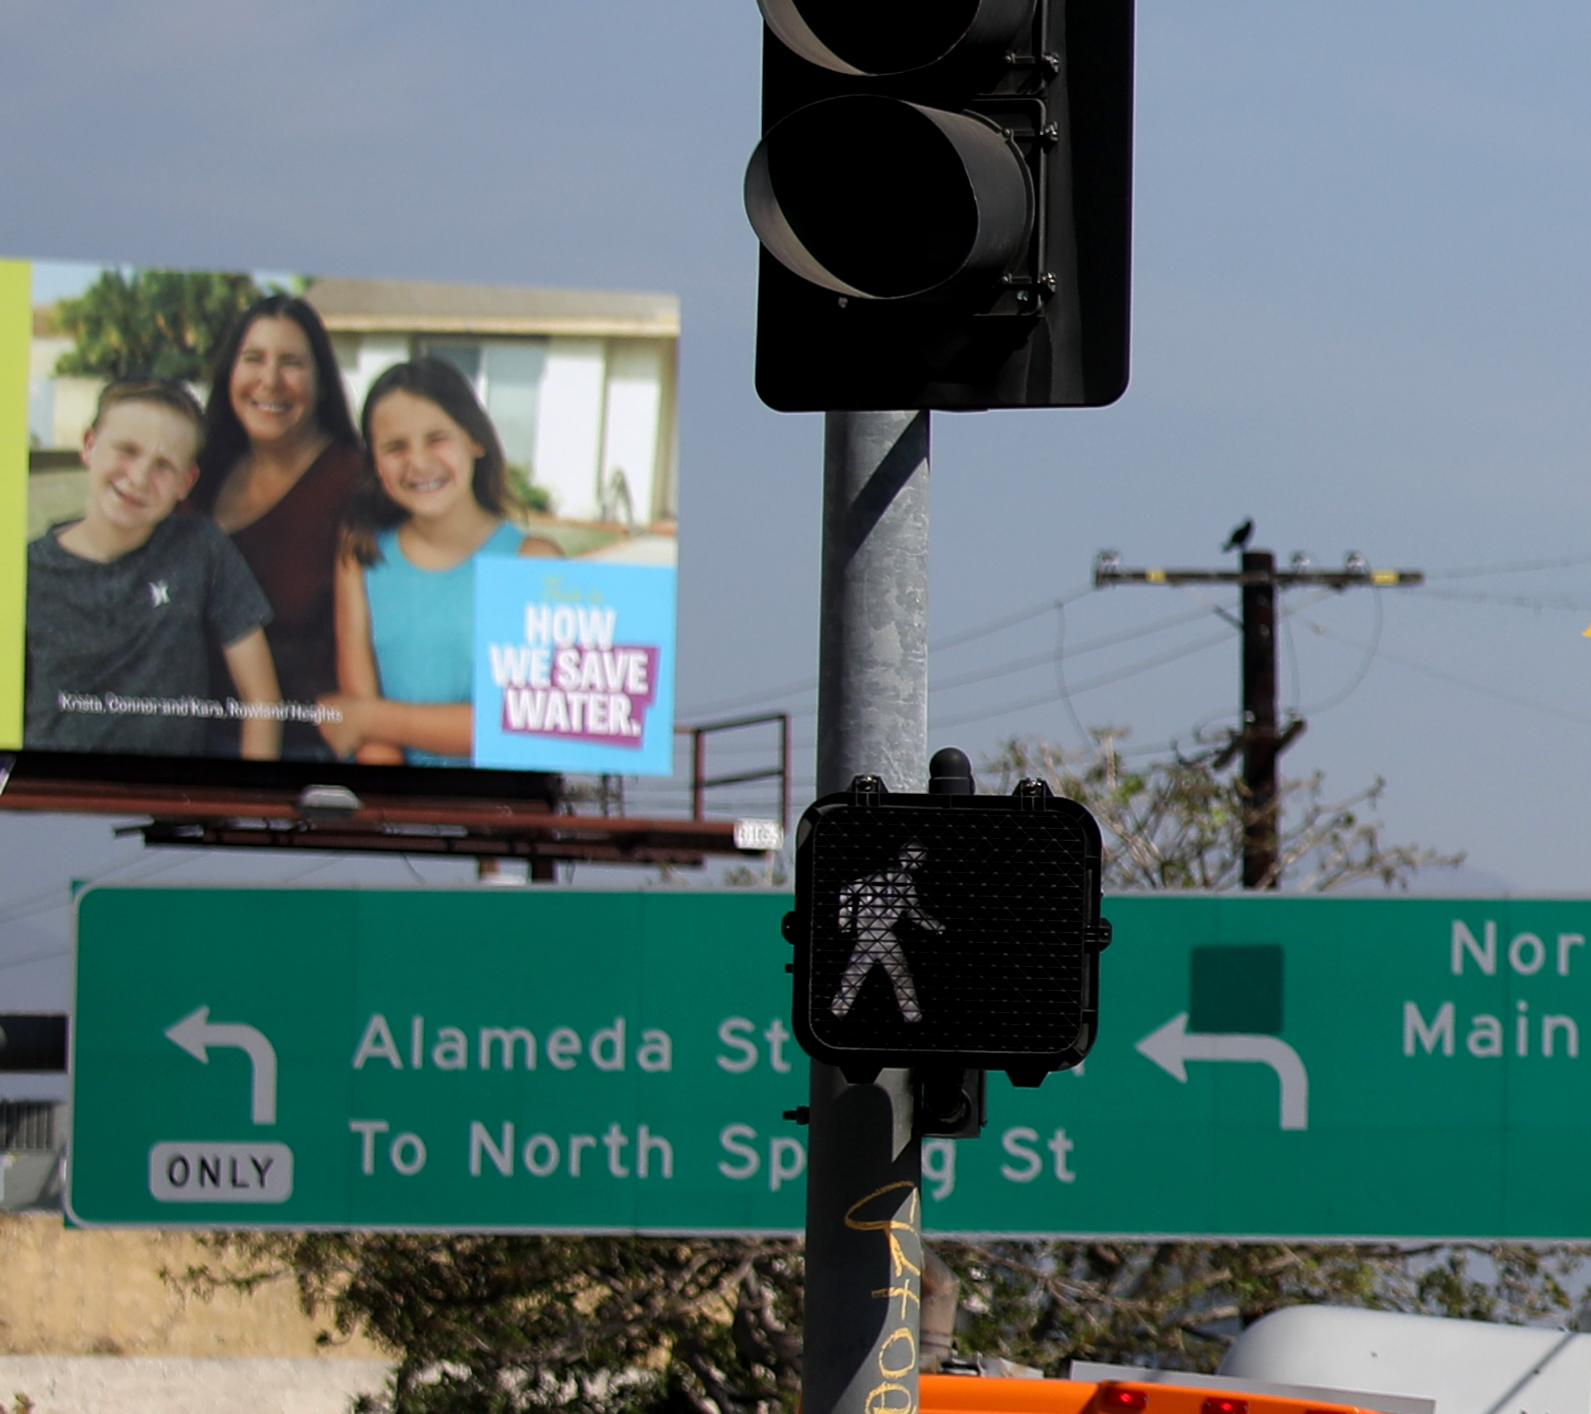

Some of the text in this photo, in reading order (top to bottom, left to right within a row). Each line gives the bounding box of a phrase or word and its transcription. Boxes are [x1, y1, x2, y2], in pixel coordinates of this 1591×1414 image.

[525, 602, 617, 650] HOW
[490, 642, 650, 695] WE SAVE
[506, 686, 642, 737] WATER.
[352, 1013, 792, 1071] Alameda St
[1401, 1000, 1581, 1058] Main
[166, 1153, 275, 1188] ONLY
[349, 1119, 1076, 1203] To North Spg St
